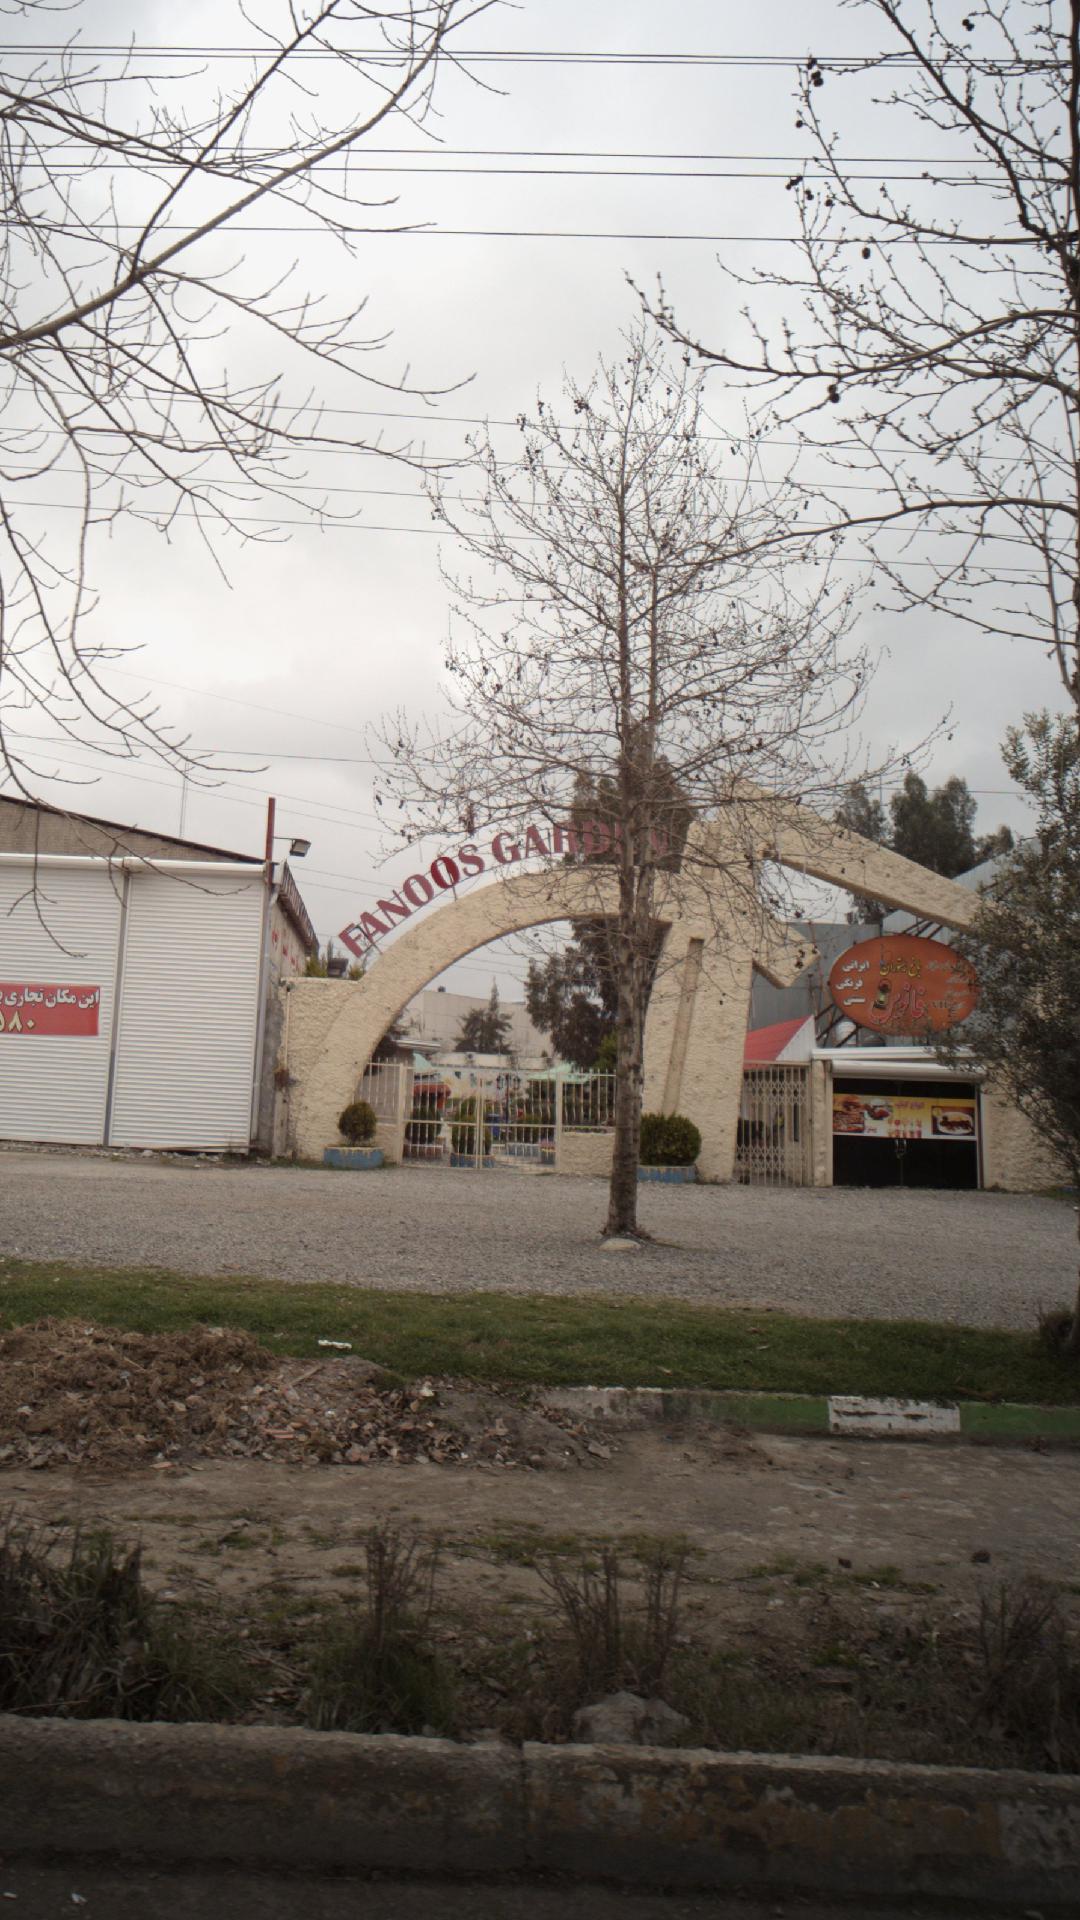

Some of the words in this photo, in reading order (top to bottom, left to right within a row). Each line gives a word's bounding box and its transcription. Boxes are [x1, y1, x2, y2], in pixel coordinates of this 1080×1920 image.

[338, 843, 485, 958] FANOOS
[842, 959, 870, 973] ایرانی
[4, 986, 44, 1008] تجاری
[45, 987, 77, 1008] مکان
[78, 988, 99, 1009] این
